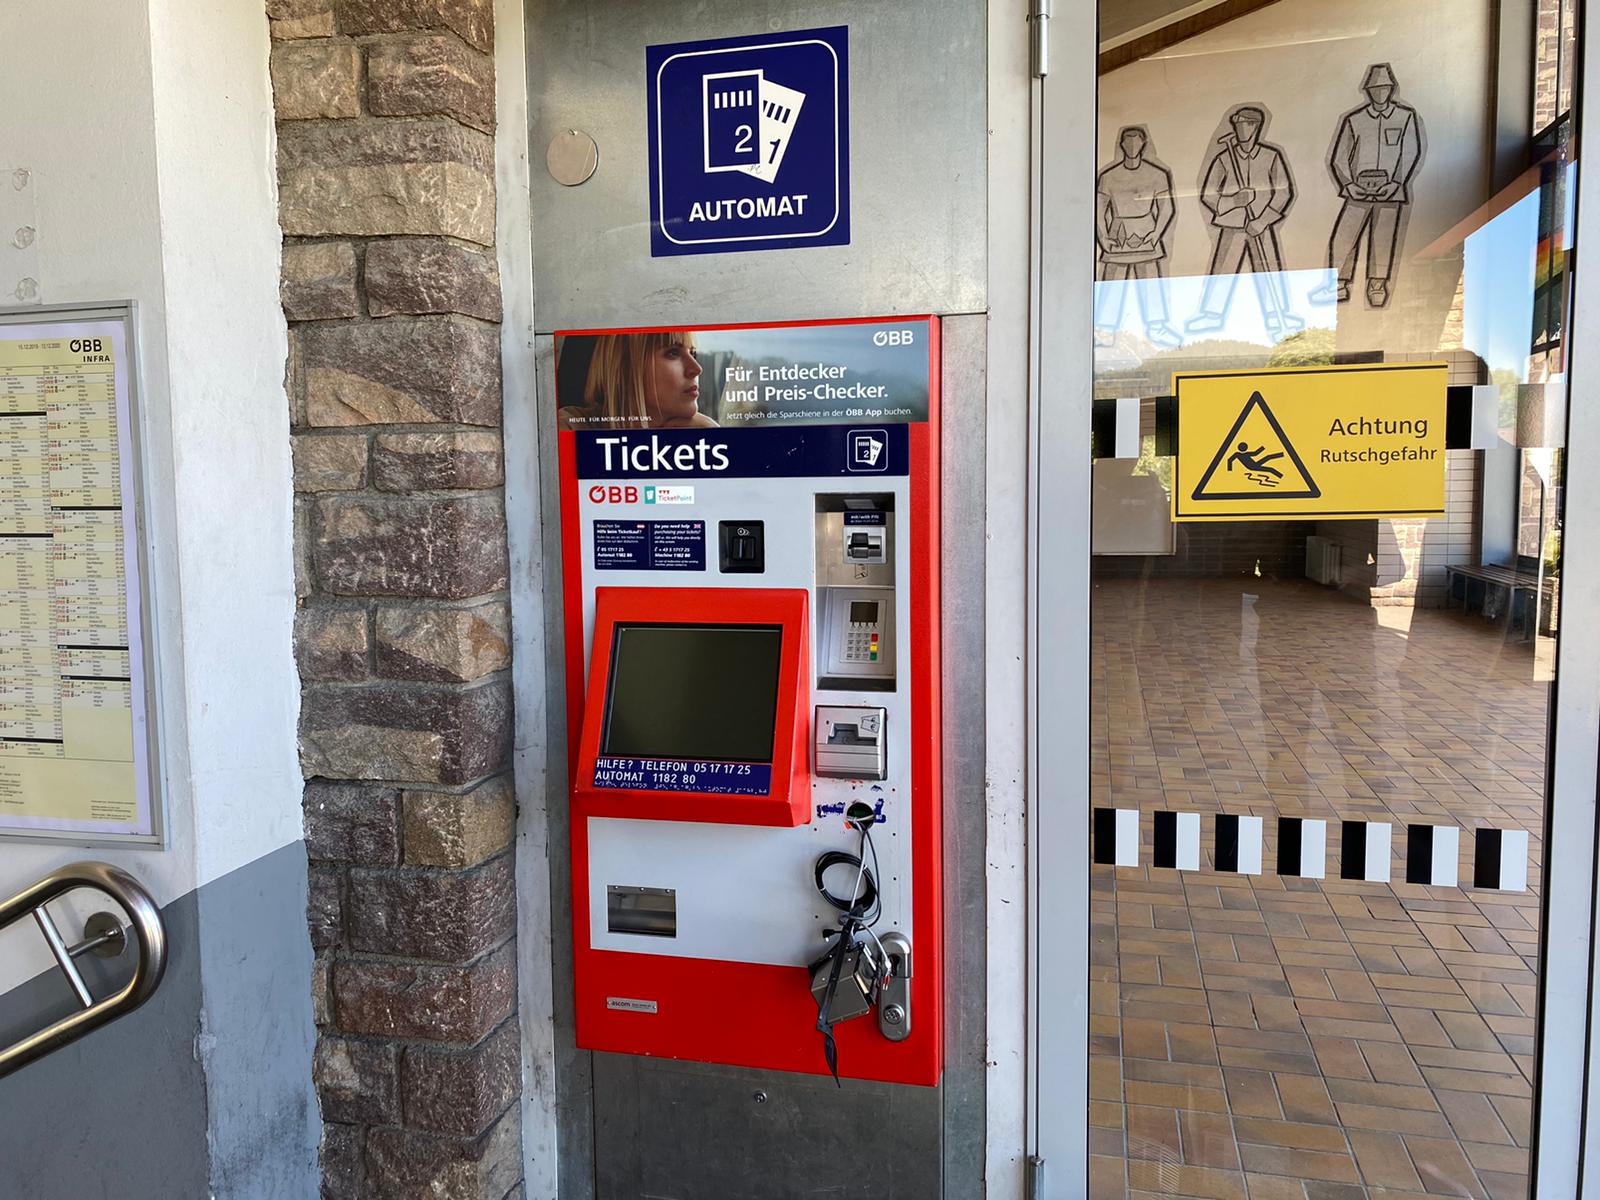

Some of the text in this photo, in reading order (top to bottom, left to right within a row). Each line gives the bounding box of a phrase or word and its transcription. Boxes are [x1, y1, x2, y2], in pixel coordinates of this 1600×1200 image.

[734, 124, 753, 153] 2
[768, 138, 781, 165] 1
[688, 194, 808, 222] AUTOMAT
[70, 339, 102, 353] ÖBB
[873, 330, 914, 347] ÖBB
[83, 355, 111, 363] INFRA
[725, 363, 847, 382] Für Entdecker
[725, 382, 888, 402] und Preis-Checker.
[726, 412, 743, 420] Jetzt
[744, 411, 765, 421] gleich
[767, 411, 778, 419] die
[779, 410, 821, 420] Sparschiene
[822, 409, 830, 417] in
[831, 409, 844, 417] der
[846, 408, 863, 417] ÖBB
[865, 408, 882, 418] App
[1328, 416, 1428, 439] Achtung
[596, 435, 729, 471] Tickets
[863, 449, 870, 458] 2
[1320, 446, 1438, 465] Rutschgefahr
[588, 485, 638, 504] ÖBB
[658, 494, 692, 502] TicketPoint
[595, 771, 696, 784] AUTOMAT 1182 80
[641, 761, 688, 772] TELEFON
[694, 763, 707, 773] 05
[737, 764, 751, 775] 25
